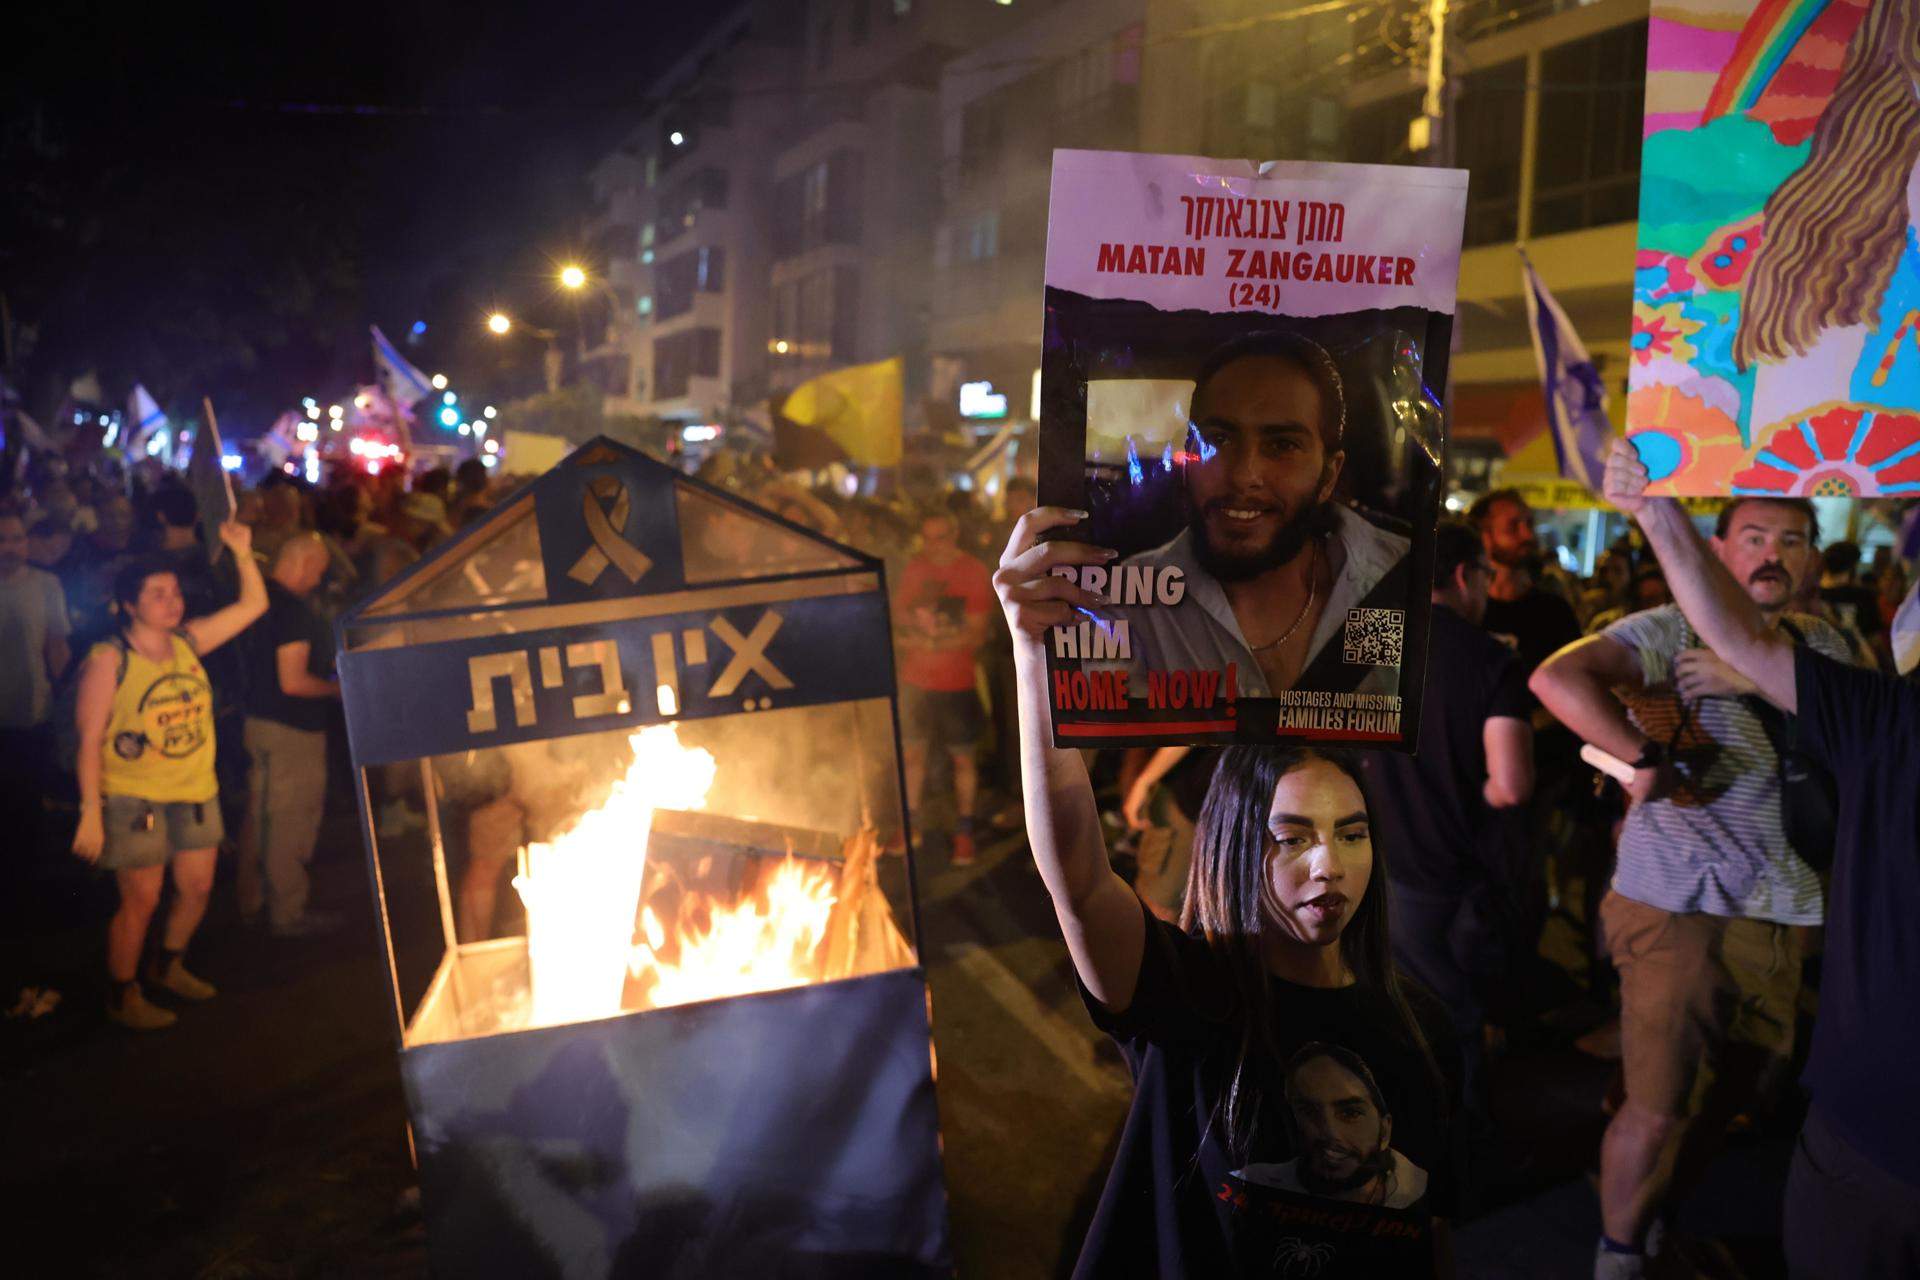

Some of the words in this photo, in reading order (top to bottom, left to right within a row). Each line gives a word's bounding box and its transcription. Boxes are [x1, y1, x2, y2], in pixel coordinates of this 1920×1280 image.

[1180, 195, 1290, 240] צנגאוקר
[1296, 201, 1345, 245] מתן
[1097, 243, 1205, 276] MATAN
[1225, 249, 1416, 286] ZANGAUKER
[1229, 282, 1281, 310] (24)
[1053, 619, 1131, 659] HIM
[466, 639, 631, 733] בית
[1053, 670, 1129, 711] HOME
[1280, 690, 1332, 707] HOSTAGES
[1333, 692, 1354, 708] AND
[1356, 694, 1402, 711] MISSING
[1279, 707, 1344, 730] FAMILIES
[1347, 709, 1400, 734] FORUM
